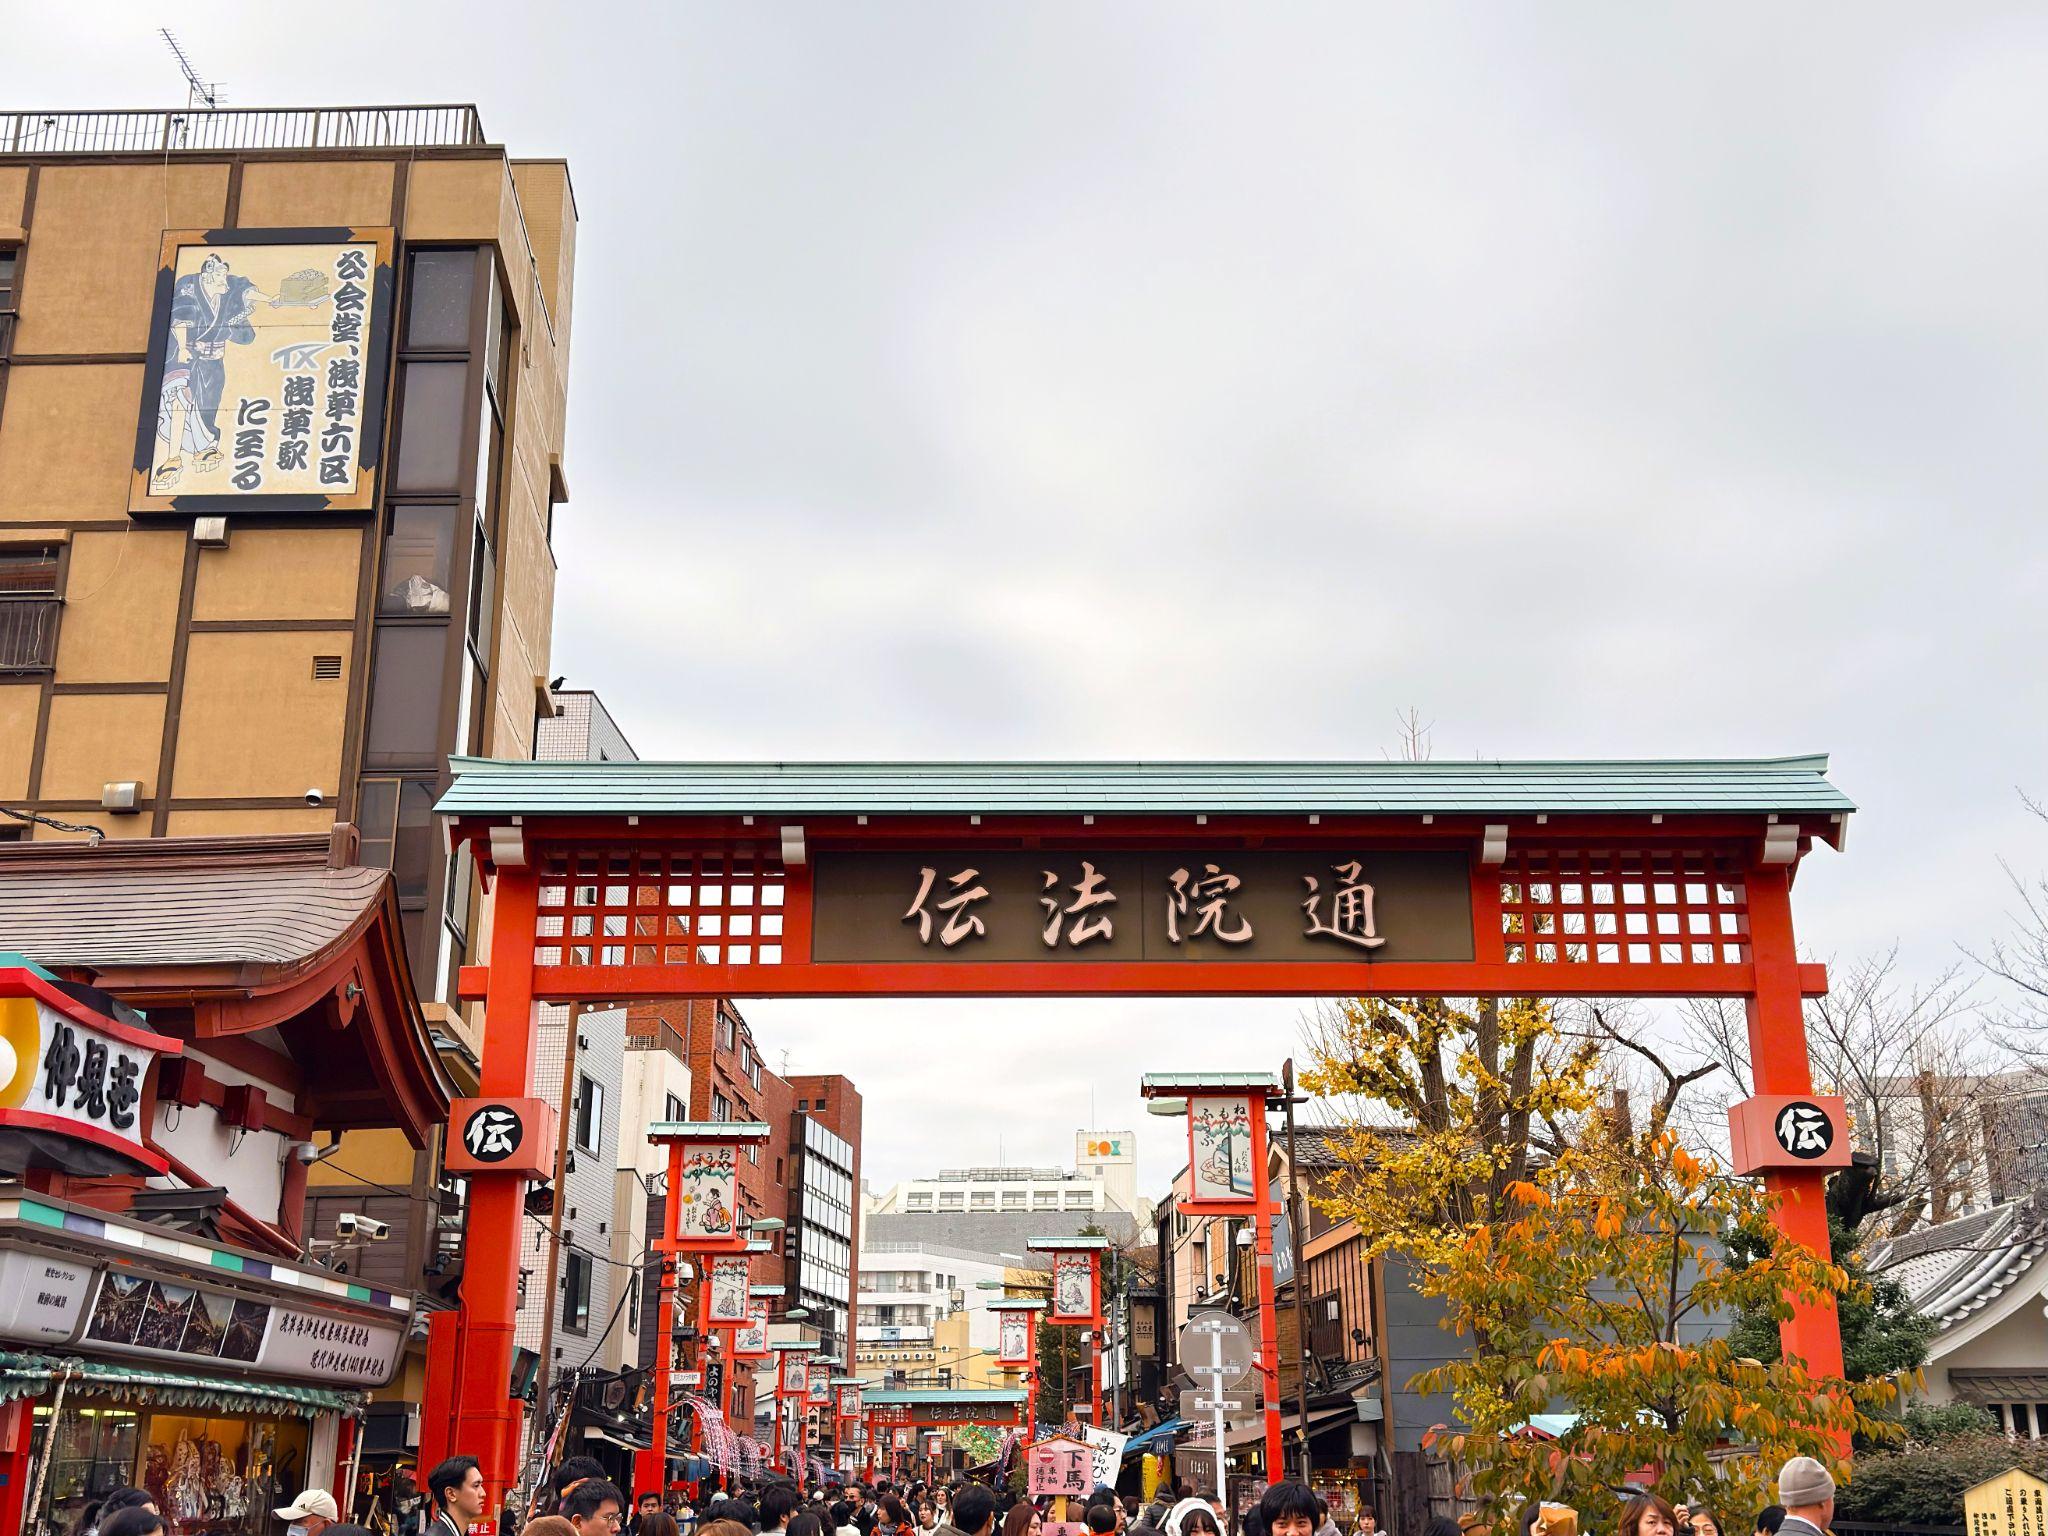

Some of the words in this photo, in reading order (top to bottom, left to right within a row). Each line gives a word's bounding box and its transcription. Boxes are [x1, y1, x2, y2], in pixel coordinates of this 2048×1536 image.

[232, 398, 270, 490] に至る
[276, 376, 315, 471] 浅草駅
[901, 860, 1388, 949] 伝法院通
[44, 1021, 139, 1129] 仲見世
[466, 1111, 515, 1154] 伝
[1087, 1140, 1121, 1156] ROX
[1779, 1108, 1824, 1151] 伝
[1063, 1449, 1086, 1491] 下馬
[468, 1522, 490, 1534] 禁止
